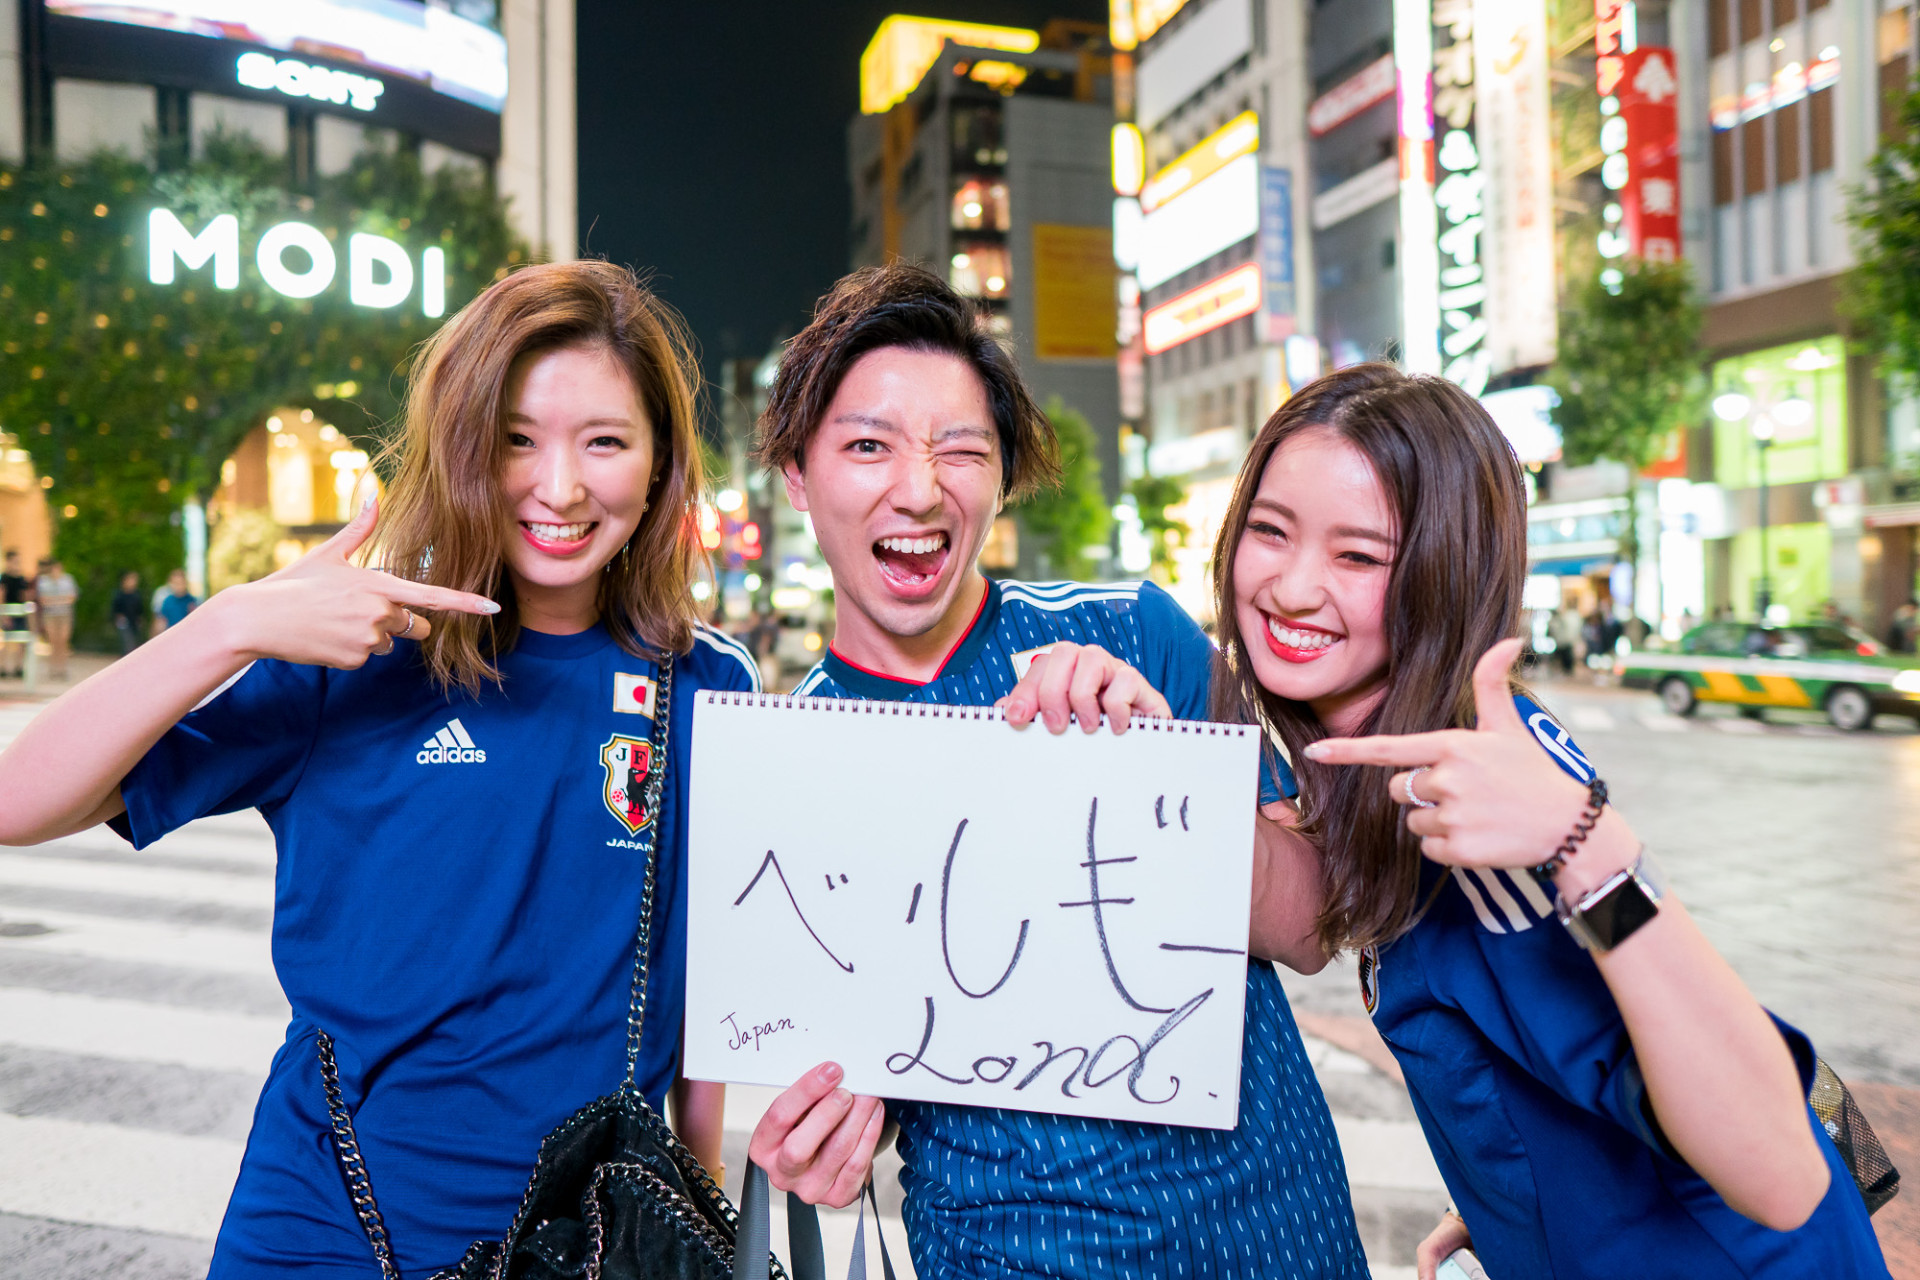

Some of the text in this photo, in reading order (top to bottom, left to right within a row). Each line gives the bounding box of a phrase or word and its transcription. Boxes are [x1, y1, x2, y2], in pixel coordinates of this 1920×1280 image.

[236, 52, 385, 111] SONY
[148, 207, 445, 318] MODI
[416, 746, 487, 765] adidas
[733, 795, 1246, 1014] ベルギー
